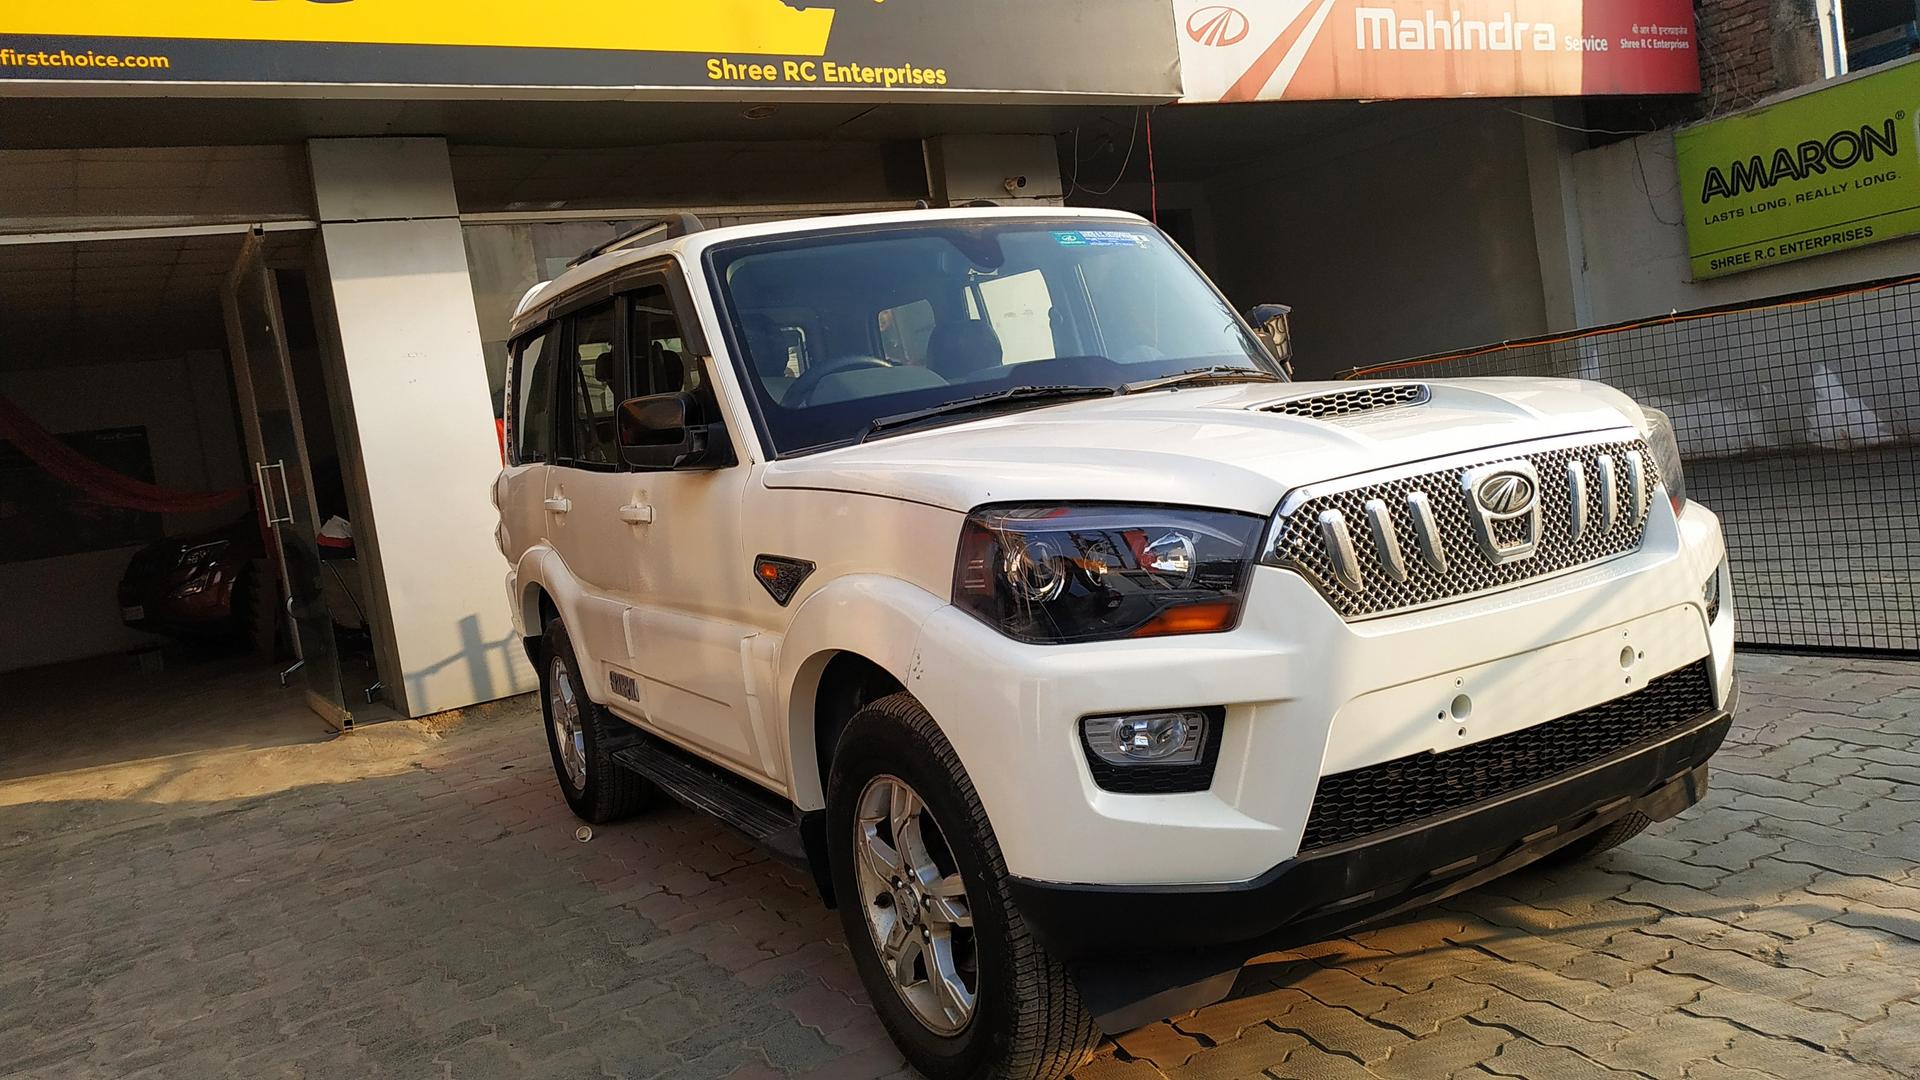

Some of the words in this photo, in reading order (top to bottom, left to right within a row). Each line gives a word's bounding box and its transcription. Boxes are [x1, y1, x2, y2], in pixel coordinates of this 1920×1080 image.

[1355, 7, 1556, 51] Mahindra
[1564, 35, 1608, 52] Service
[1620, 38, 1640, 49] Shree
[1640, 38, 1646, 48] R
[1647, 38, 1652, 48] C
[1653, 38, 1689, 51] Enterprises
[706, 58, 777, 81] Shree
[782, 61, 817, 82] RC
[822, 62, 947, 88] Enterprises
[1704, 208, 1745, 226] LASTS
[1796, 182, 1848, 204] REALLY
[1855, 171, 1902, 190] LONG.
[1710, 252, 1751, 271] SHREE
[1755, 247, 1776, 261] R.C
[1779, 225, 1874, 256] ENTERPRISES
